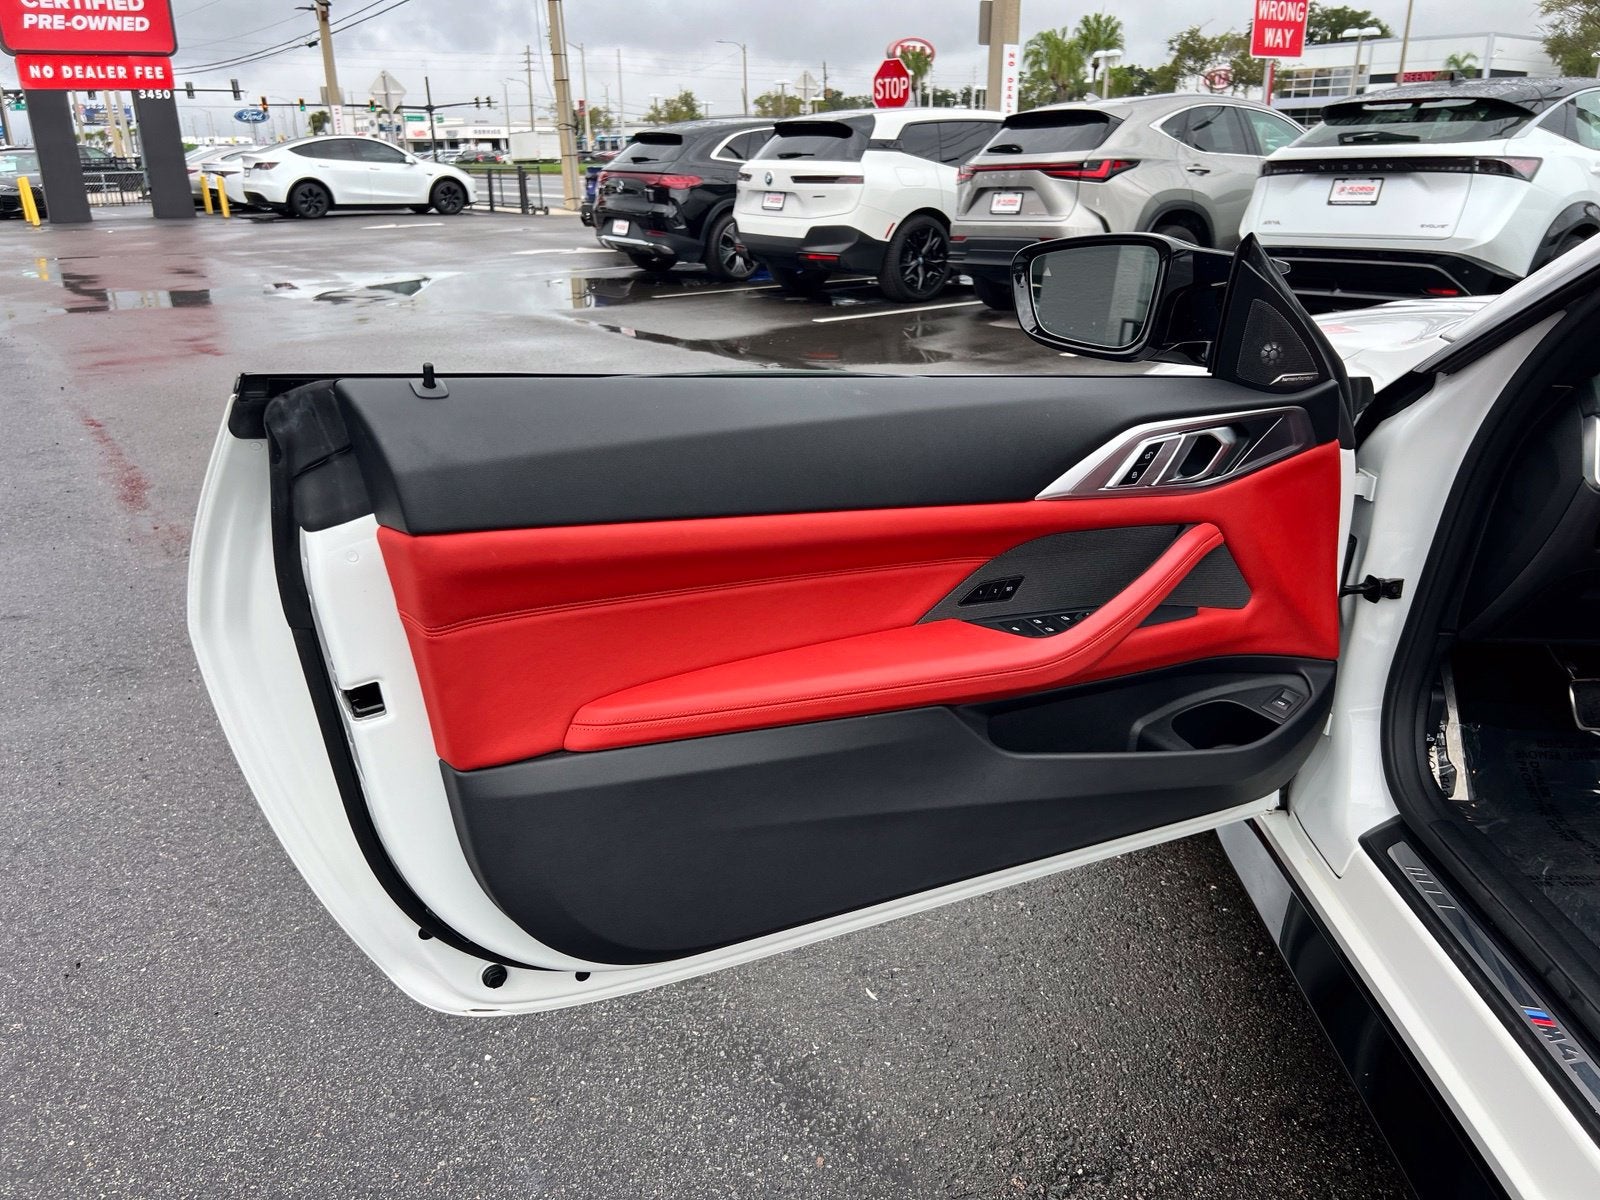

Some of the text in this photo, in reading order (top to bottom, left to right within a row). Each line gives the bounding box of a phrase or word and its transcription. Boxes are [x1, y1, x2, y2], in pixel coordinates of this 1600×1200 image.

[21, 0, 145, 11] CERTIFIED
[1258, 0, 1306, 22] WRONG
[23, 14, 151, 32] PRE-OWNED
[1264, 28, 1295, 49] WAY
[29, 65, 165, 80] NO DEALER FEE
[139, 89, 171, 100] 3450
[875, 77, 910, 100] STOP
